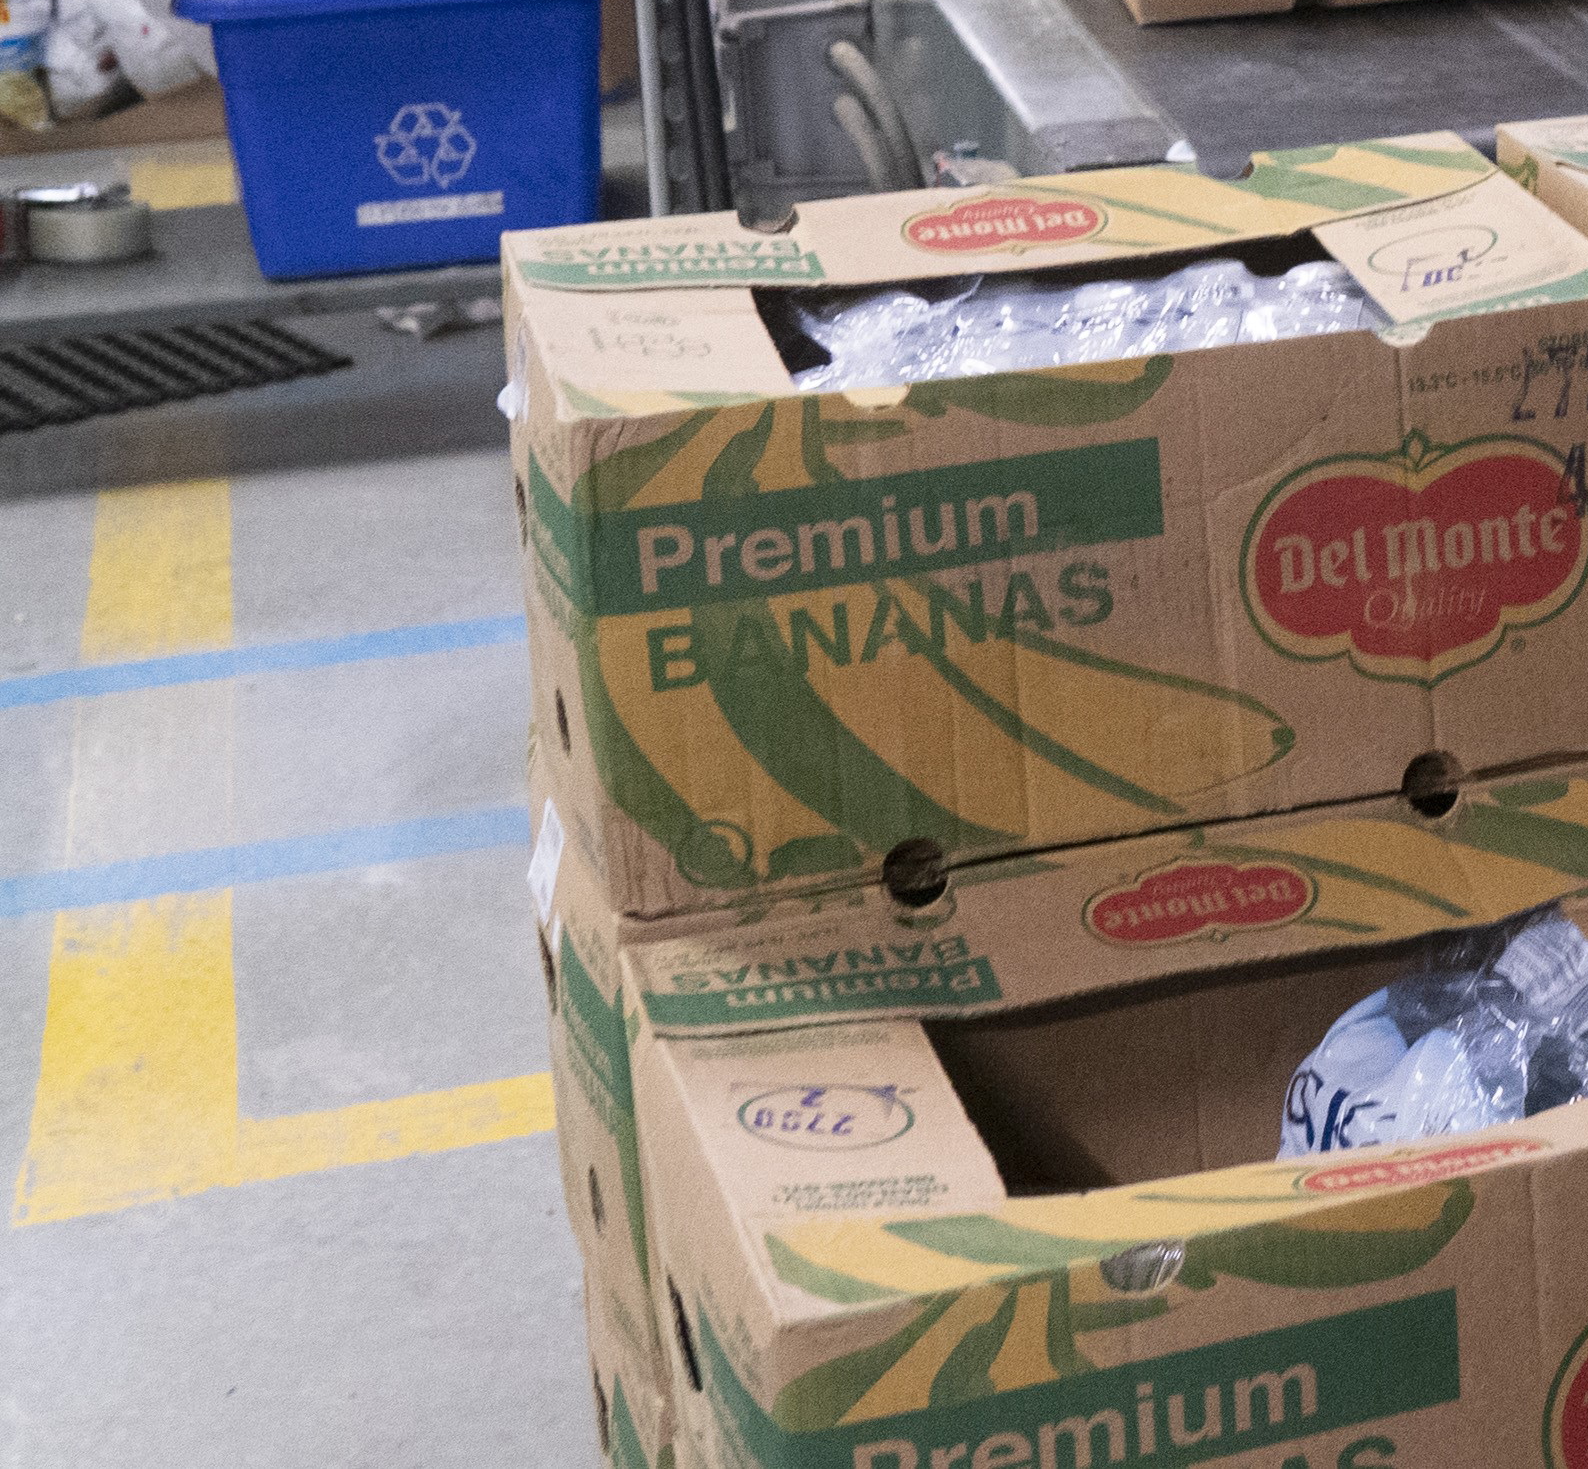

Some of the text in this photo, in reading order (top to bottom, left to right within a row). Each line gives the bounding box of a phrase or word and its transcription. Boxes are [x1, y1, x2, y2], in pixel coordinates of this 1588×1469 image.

[636, 489, 1040, 595] Premium
[1274, 503, 1569, 594] Del Monte
[646, 561, 1116, 693] BANANAS
[1101, 878, 1297, 931] Del Monte
[670, 935, 971, 994] BANANAS
[726, 965, 983, 1011] Premium
